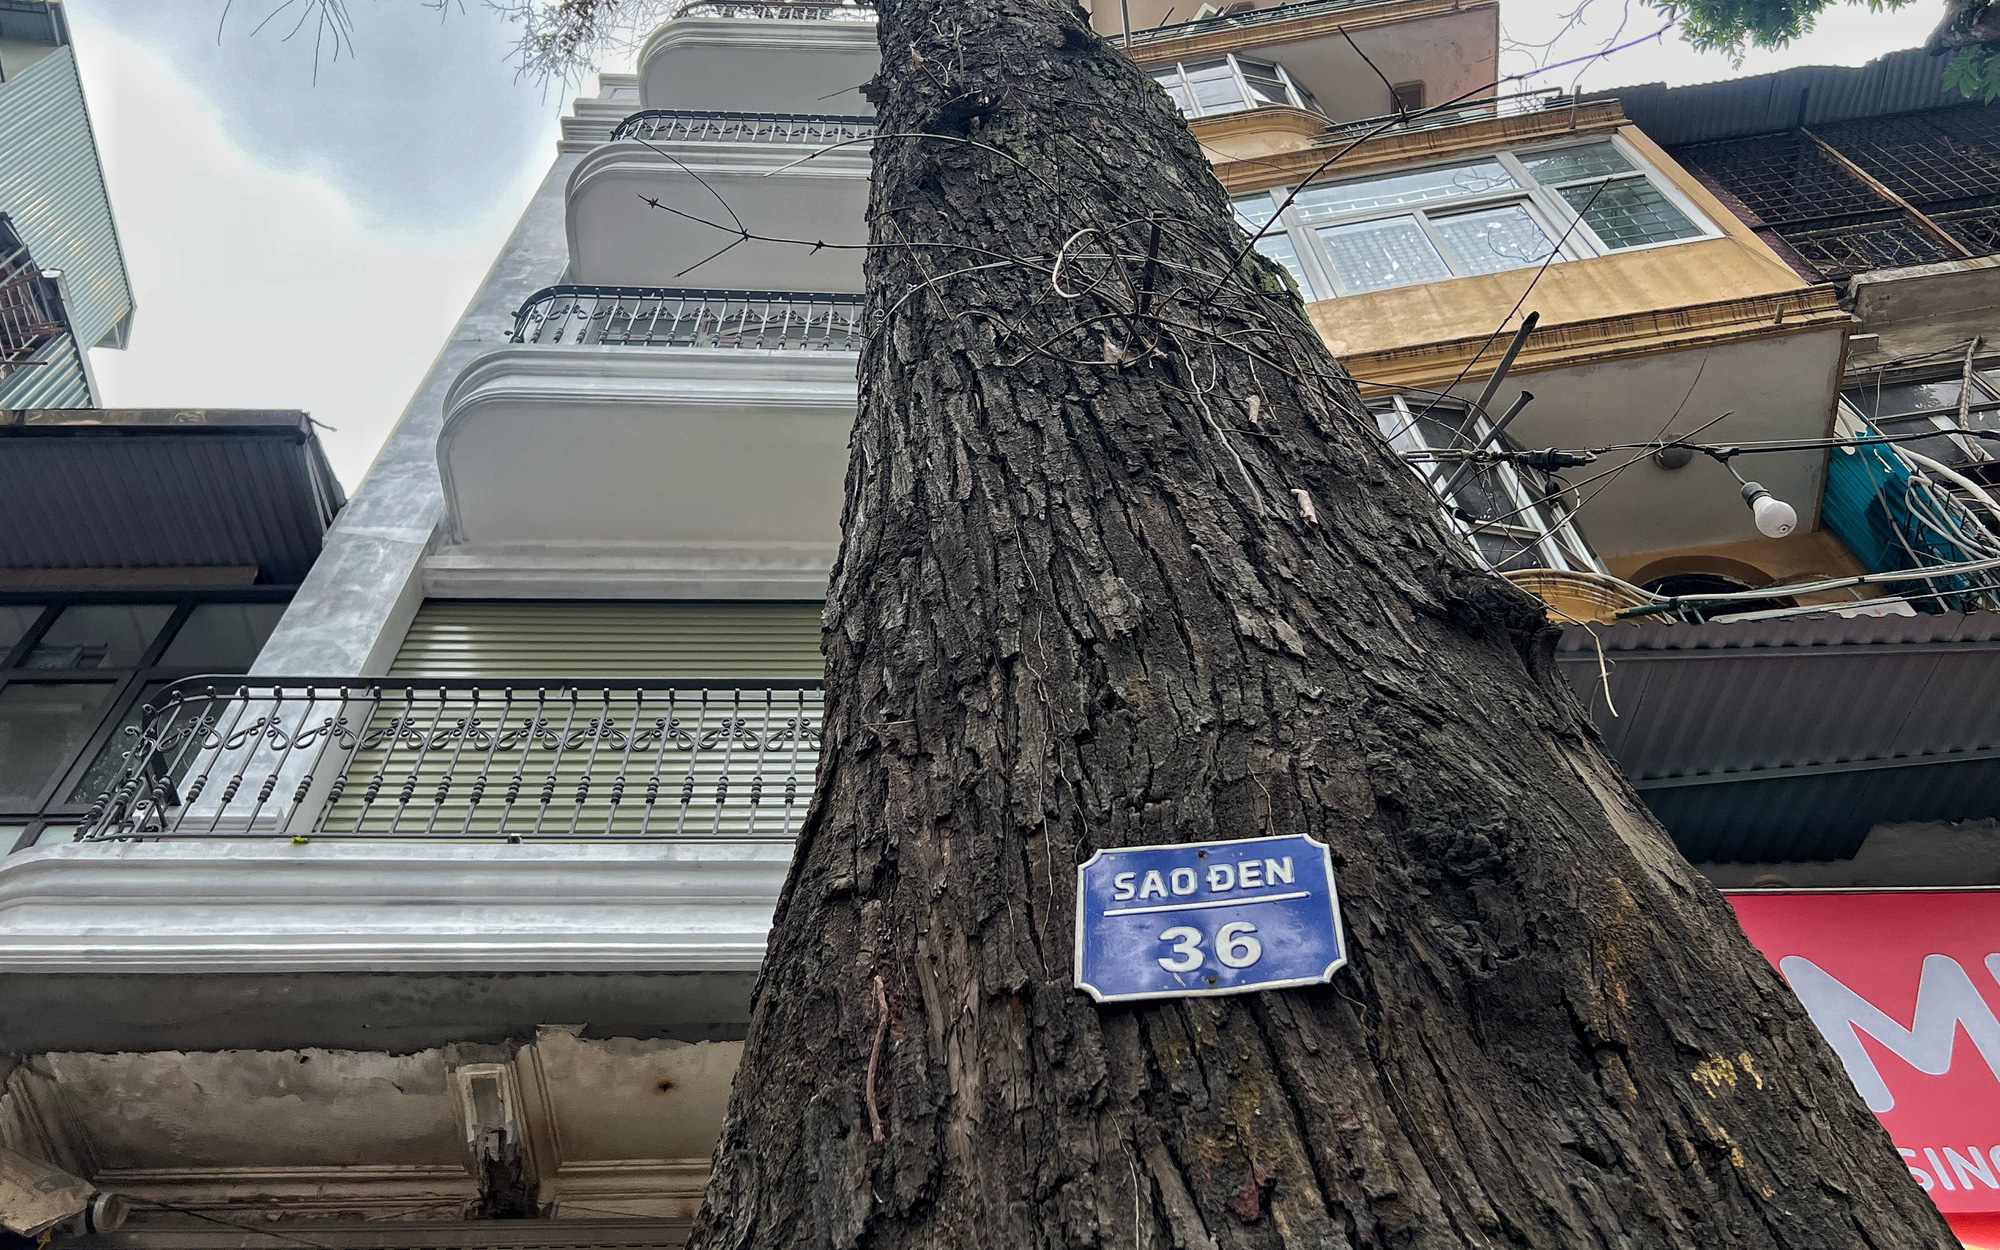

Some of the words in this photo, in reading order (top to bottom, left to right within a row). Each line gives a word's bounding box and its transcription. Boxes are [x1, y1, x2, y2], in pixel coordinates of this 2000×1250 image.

[1112, 866, 1198, 901] SAO
[1206, 855, 1295, 893] ĐEN
[1158, 921, 1262, 972] 36
[1779, 953, 2000, 1113] M
